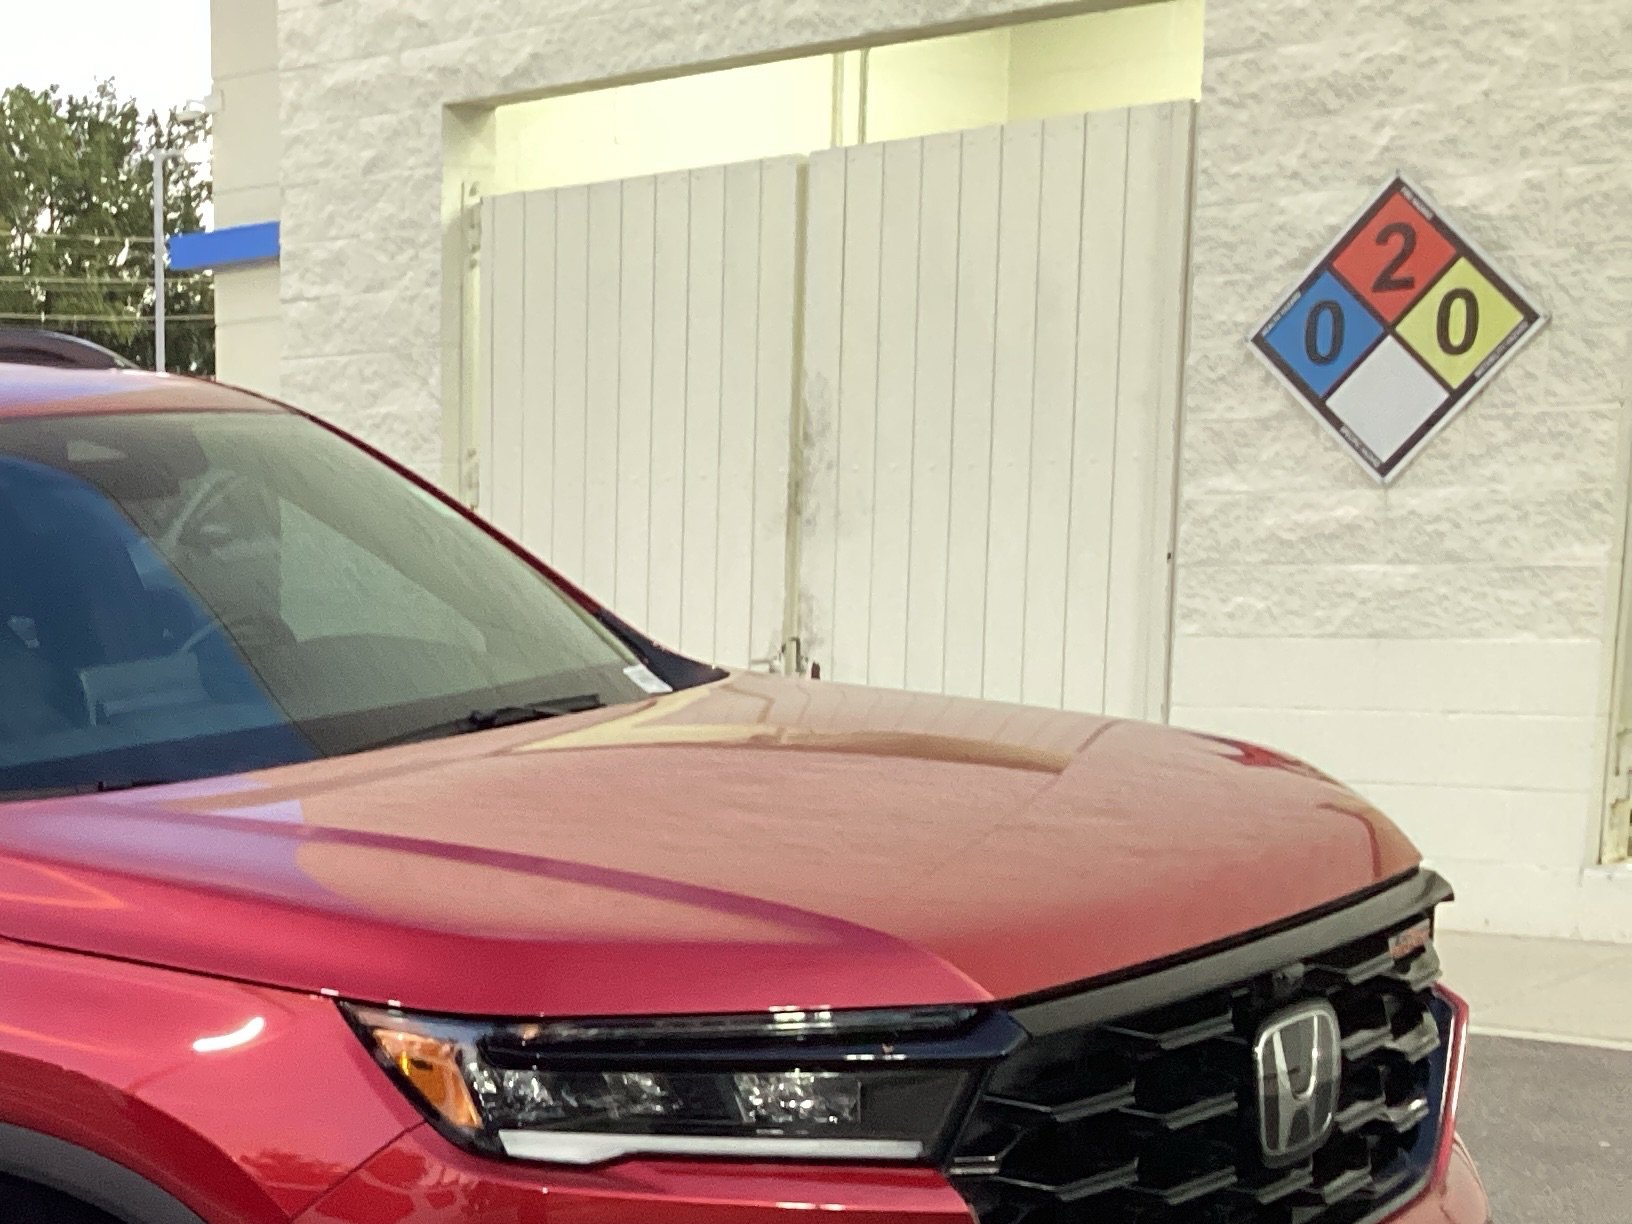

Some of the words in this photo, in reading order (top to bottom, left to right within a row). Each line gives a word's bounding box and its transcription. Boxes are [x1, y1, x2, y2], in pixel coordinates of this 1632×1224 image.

[1372, 222, 1417, 293] 2
[1304, 299, 1345, 366] 0
[1436, 288, 1480, 355] 0
